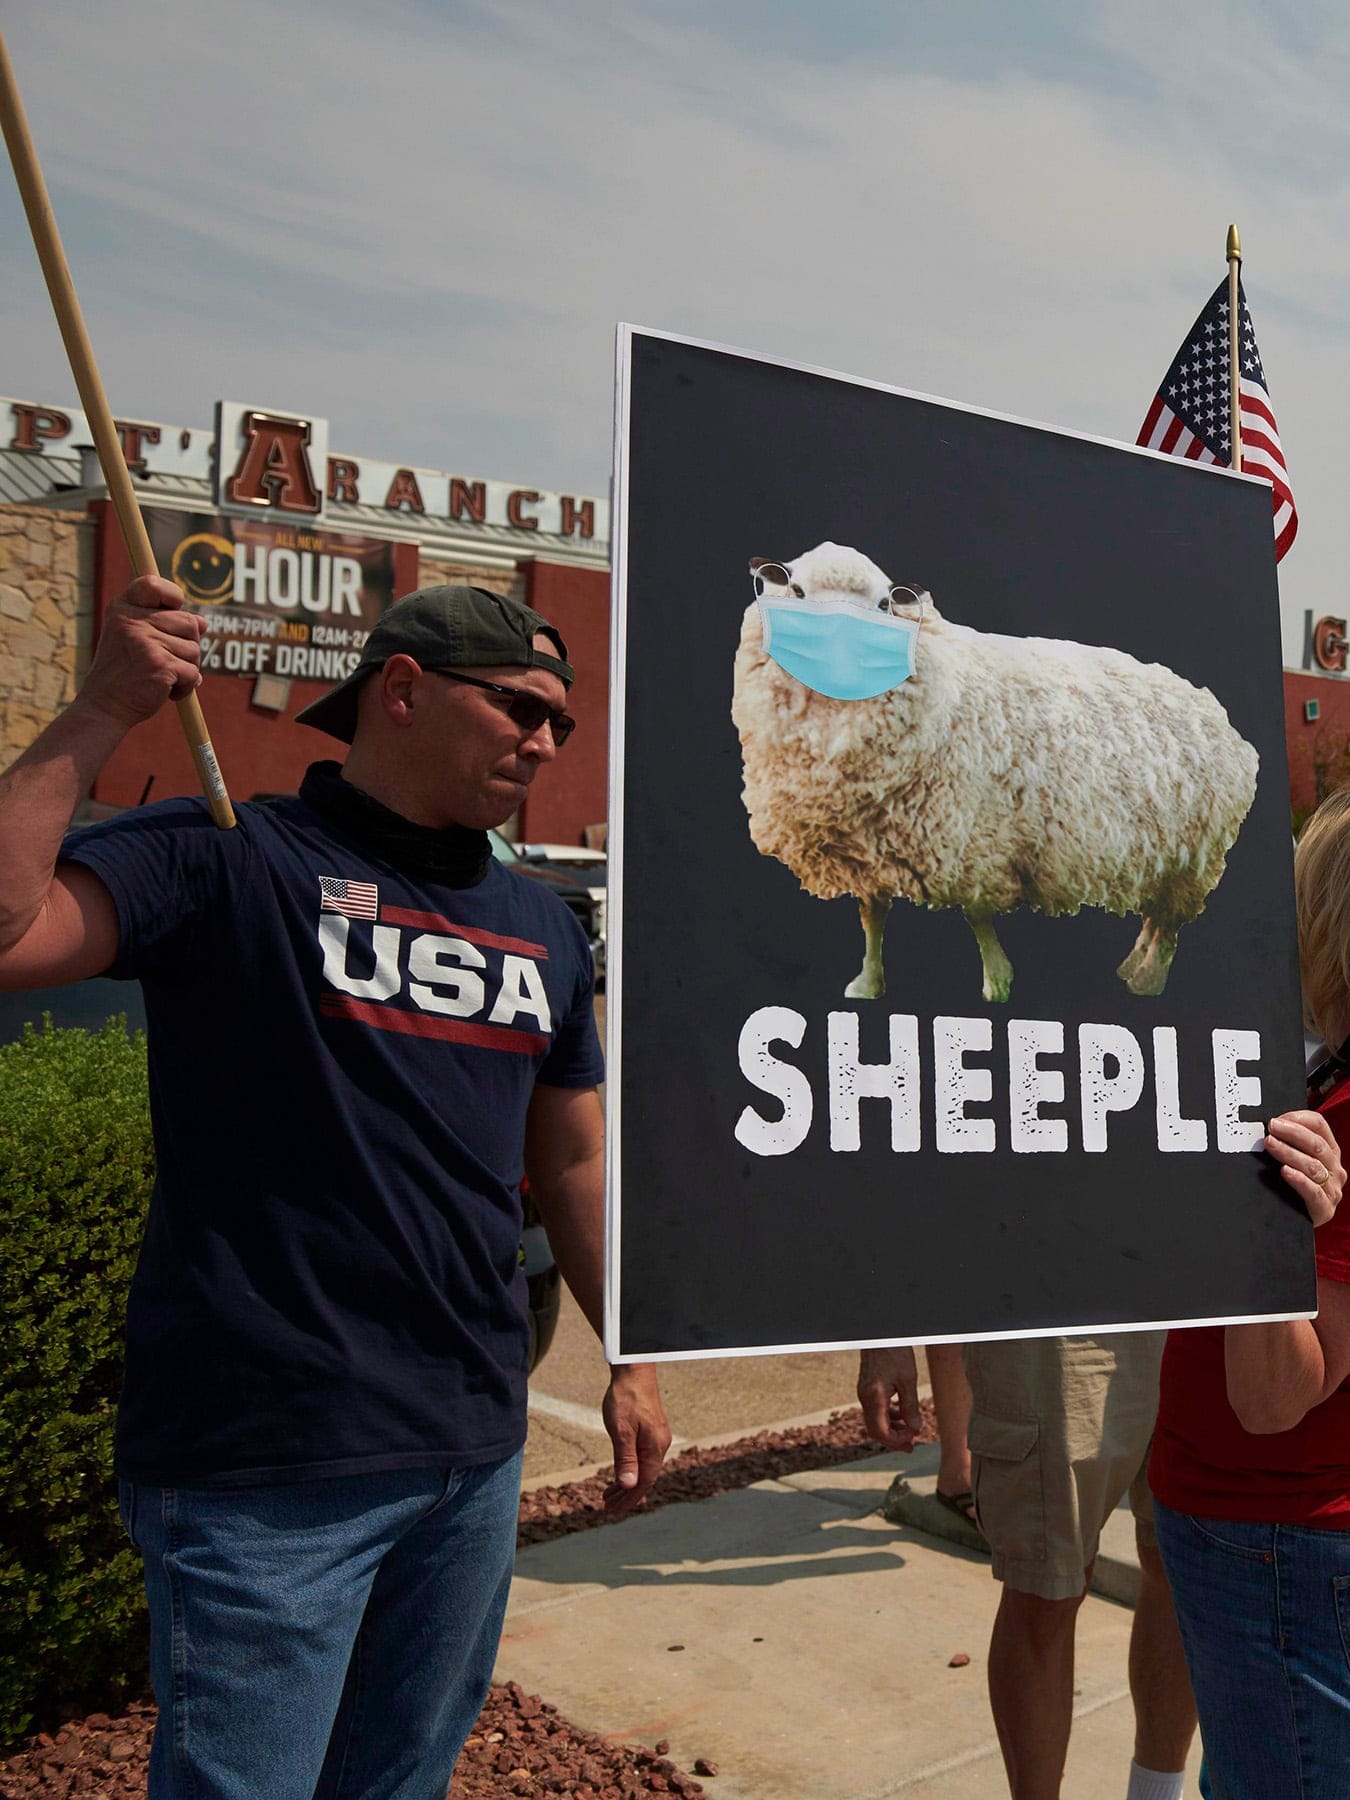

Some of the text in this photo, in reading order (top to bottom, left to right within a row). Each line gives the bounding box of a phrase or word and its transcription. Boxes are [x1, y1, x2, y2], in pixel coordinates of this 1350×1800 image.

[11, 403, 594, 538] PT' A RANCH
[275, 532, 324, 551] ALL NEW
[233, 543, 363, 617] HOUR
[224, 639, 271, 672] OFF
[276, 646, 361, 680] DRINKS
[279, 622, 309, 642] AND
[318, 914, 552, 1033] USA
[734, 1005, 1265, 1156] SHEEPLE
